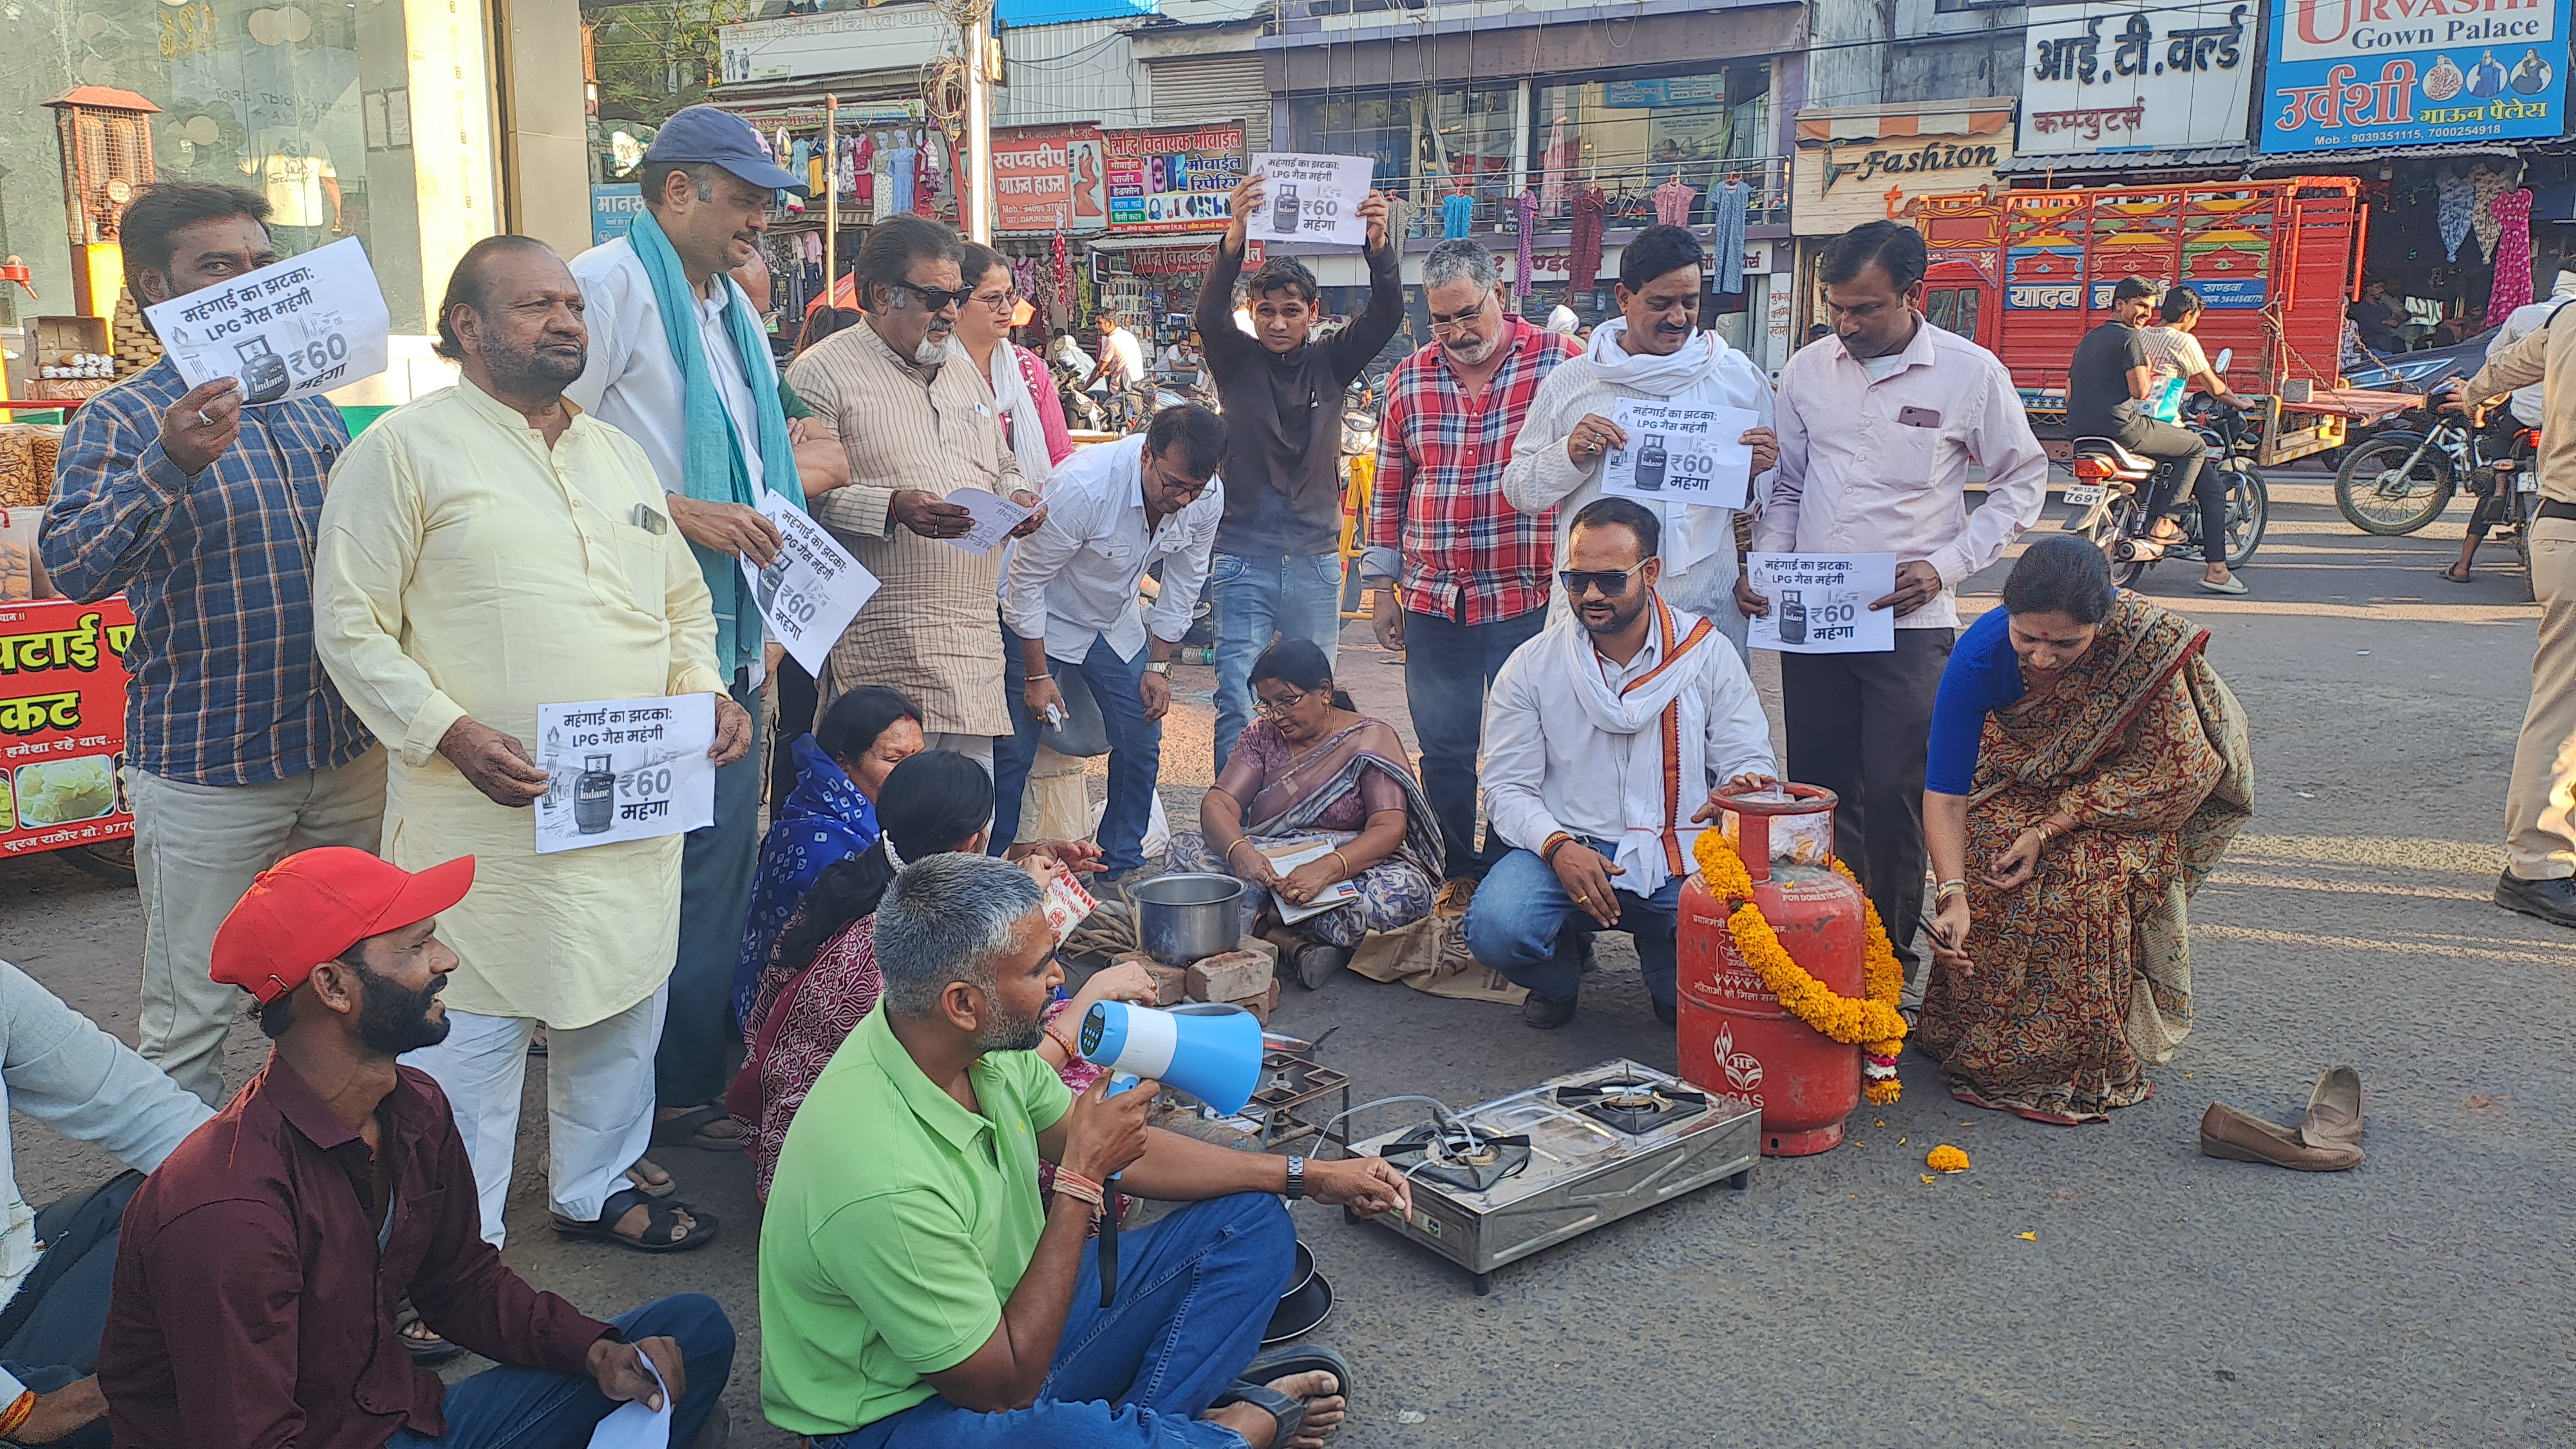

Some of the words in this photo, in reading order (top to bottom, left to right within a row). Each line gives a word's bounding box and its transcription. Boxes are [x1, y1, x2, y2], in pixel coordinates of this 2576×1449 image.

[2352, 26, 2433, 50] Gown
[2447, 18, 2539, 41] Palace
[2275, 59, 2418, 131] उर्वशी
[2419, 106, 2485, 124] गाऊन
[2488, 99, 2548, 120] पैलेस
[1108, 130, 1139, 156] सिद्धि
[1140, 129, 1191, 154] विनायक
[1191, 124, 1242, 151] मोबाईल
[2315, 135, 2340, 146] Mob
[2351, 130, 2424, 144] 9039351115,
[2428, 124, 2501, 138] 7000254918
[993, 142, 1066, 170] स्वप्नदीप
[1187, 153, 1242, 172] मोबाईल
[1857, 142, 1998, 181] Fashion
[998, 176, 1032, 194] गाऊन
[1033, 175, 1066, 196] हाऊस
[1190, 173, 1243, 193] रिपेरिंग
[1292, 169, 1307, 180] गैस
[1302, 200, 1338, 216] ₹60
[2009, 285, 2083, 310] यादव
[2202, 283, 2244, 293] खण्डवा
[180, 289, 240, 324] महंगाई
[238, 284, 263, 303] का
[205, 320, 242, 341] LPG
[241, 307, 274, 325] गैस
[271, 287, 314, 317] महंगी
[288, 332, 347, 376] ₹60
[294, 363, 348, 392] महंगा
[1633, 405, 1668, 418] महंगाई
[1668, 410, 1681, 419] का
[1637, 420, 1658, 429] LPG
[1660, 419, 1677, 431] गैस
[1680, 421, 1708, 433] महंगी
[1671, 453, 1713, 474] ₹60
[1670, 473, 1710, 491] महंगा
[2067, 493, 2101, 504] 7691
[782, 509, 816, 540] महंगाई
[811, 536, 824, 551] का
[797, 544, 813, 562] गैस
[811, 558, 834, 582] महंगी
[1765, 558, 1799, 570] महंगाई
[1800, 561, 1815, 570] का
[1772, 574, 1792, 583] LPG
[1795, 572, 1812, 584] गैस
[1815, 573, 1844, 585] महंगी
[780, 583, 817, 623] ₹60
[1811, 603, 1855, 623] ₹60
[775, 607, 803, 641] महंगा
[1813, 623, 1855, 639] महंगा
[0, 692, 79, 732] कट
[564, 708, 608, 727] महंगाई
[609, 712, 625, 723] का
[628, 708, 672, 723] झटका:
[5, 741, 50, 759] हमेशा
[52, 736, 76, 750] रहे
[573, 734, 599, 748] LPG
[602, 727, 624, 744] गैस
[627, 724, 663, 743] महंगी
[618, 768, 672, 798] ₹60
[620, 798, 669, 821] महंगा
[4, 838, 38, 851] सूरज
[40, 829, 79, 844] राठौर
[80, 825, 101, 837] मो.
[104, 820, 135, 834] 9770
